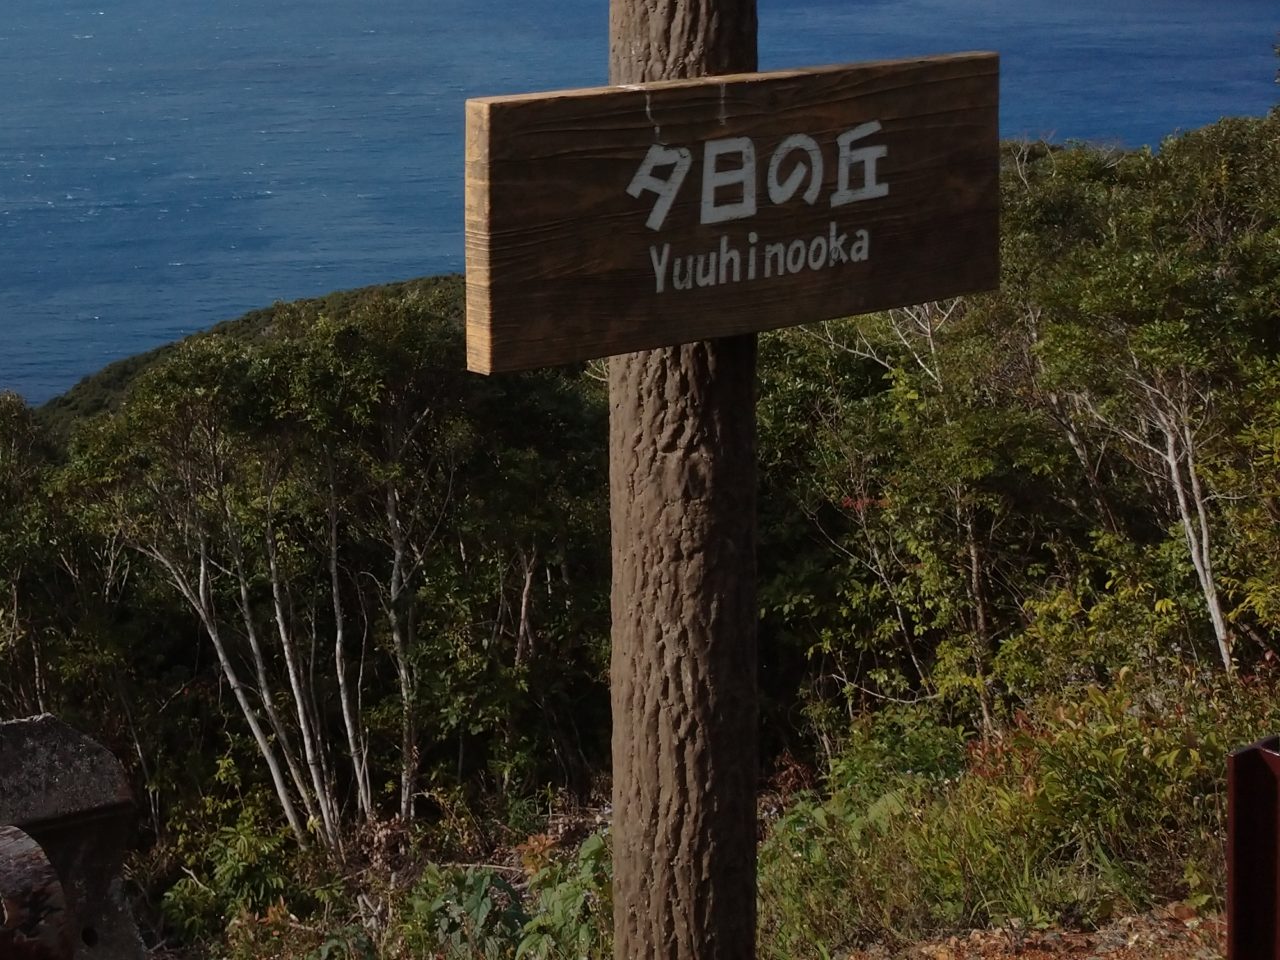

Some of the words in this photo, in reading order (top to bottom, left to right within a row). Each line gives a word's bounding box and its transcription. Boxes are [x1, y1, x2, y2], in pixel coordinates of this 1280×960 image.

[626, 120, 890, 231] 夕日の丘
[649, 222, 870, 293] Yuuhinooka
